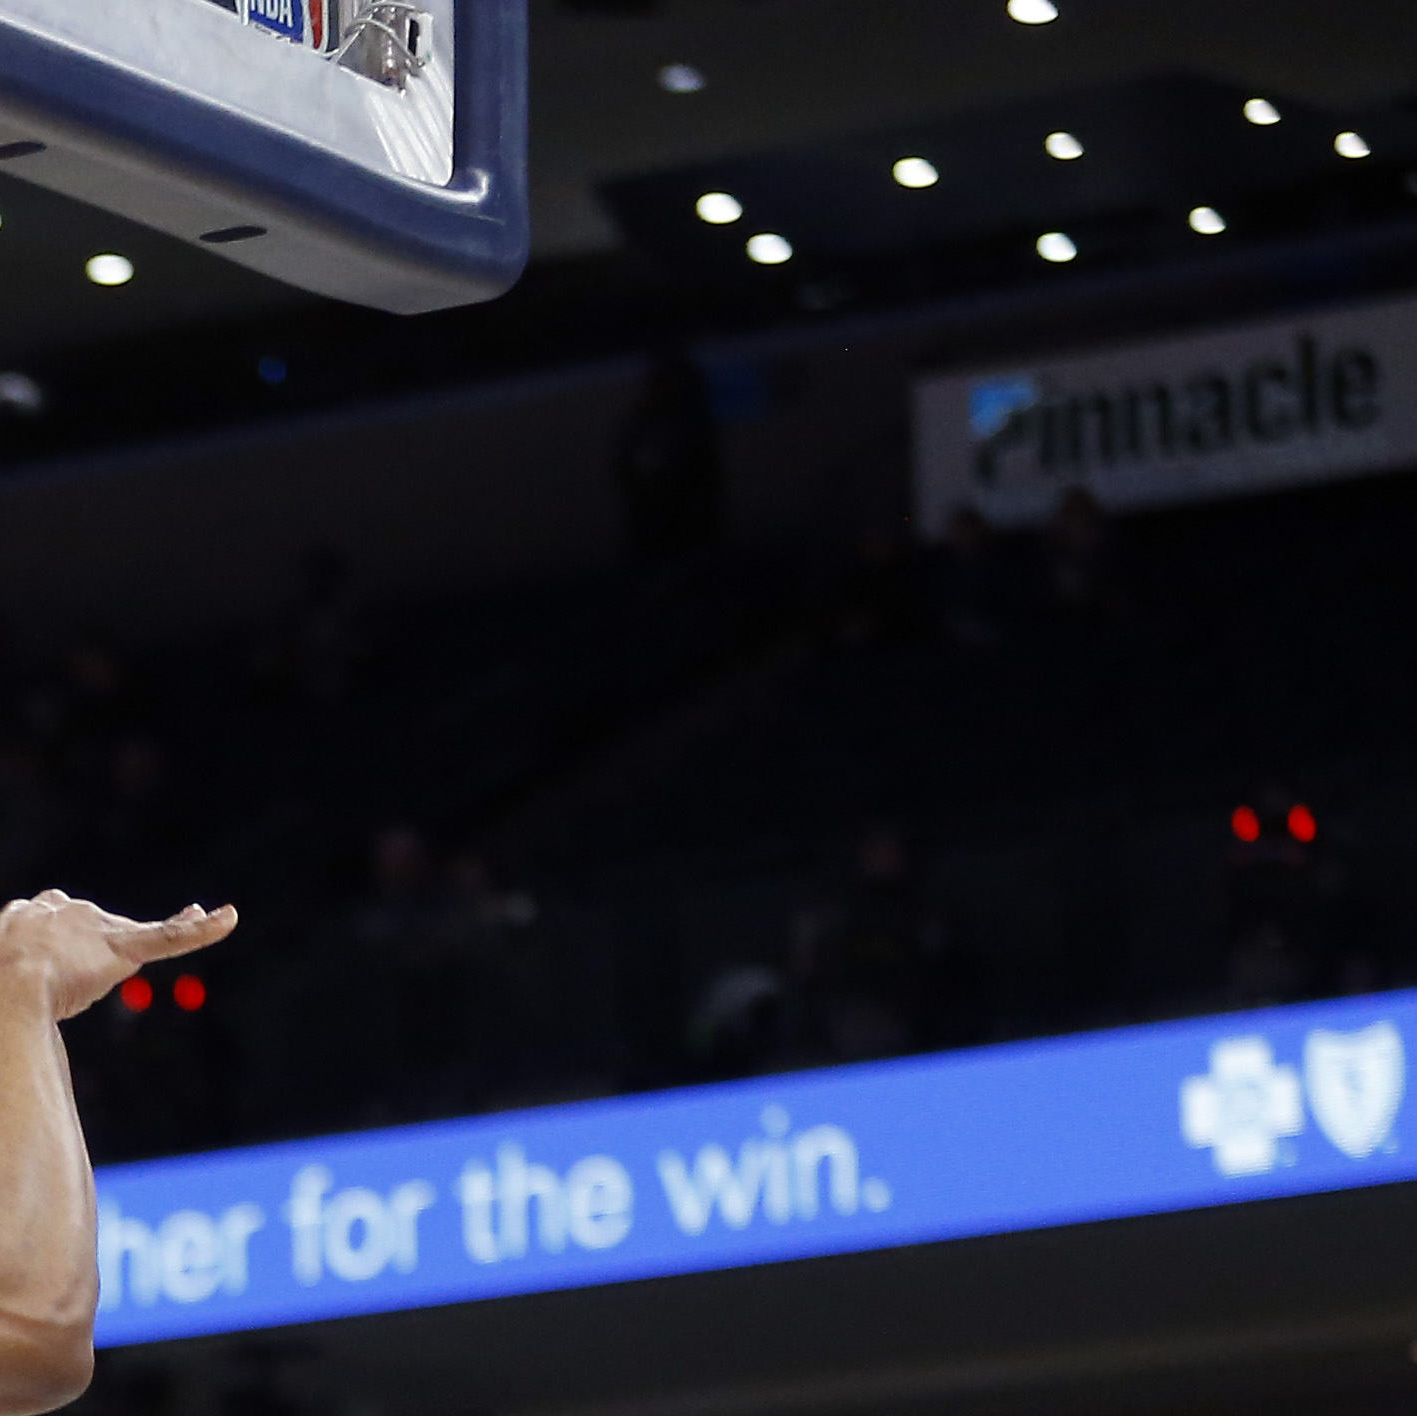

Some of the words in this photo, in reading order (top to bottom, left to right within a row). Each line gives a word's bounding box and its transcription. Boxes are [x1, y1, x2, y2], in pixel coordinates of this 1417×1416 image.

[285, 1161, 437, 1287] for
[456, 1140, 634, 1265] the
[656, 1102, 891, 1236] win.
